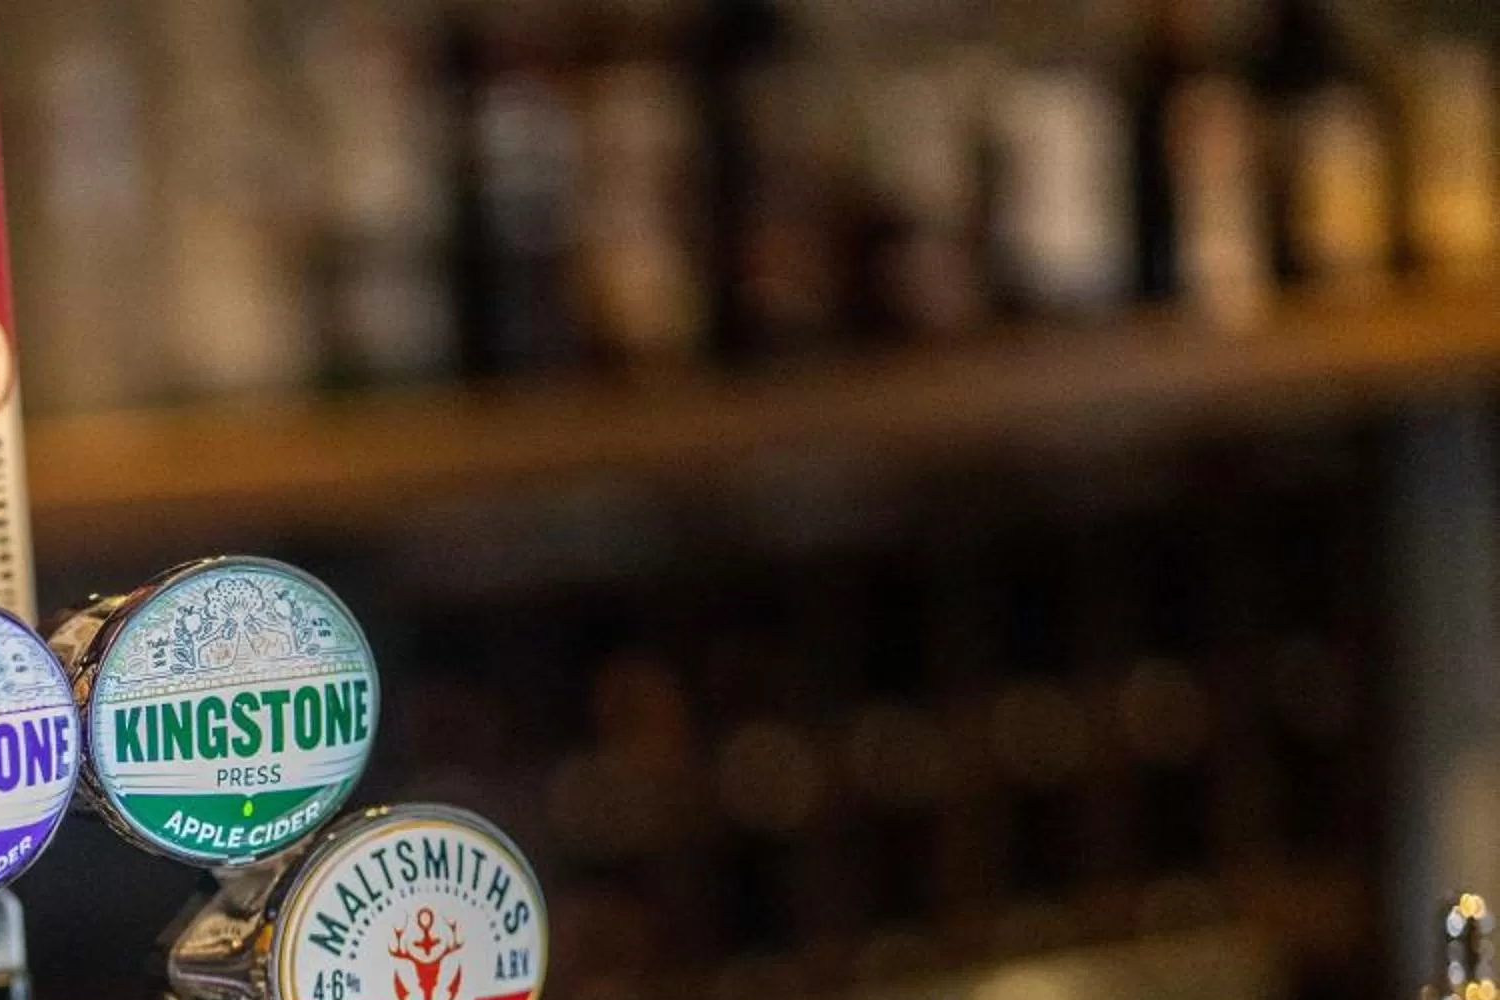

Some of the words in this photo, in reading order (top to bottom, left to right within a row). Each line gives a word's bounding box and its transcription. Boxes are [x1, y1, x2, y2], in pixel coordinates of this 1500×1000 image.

[114, 679, 368, 763] KINGSTONE
[217, 764, 281, 786] PRESS
[163, 810, 244, 849] APPLE
[248, 801, 320, 846] CIDER
[308, 836, 529, 956] MALTSMITHS
